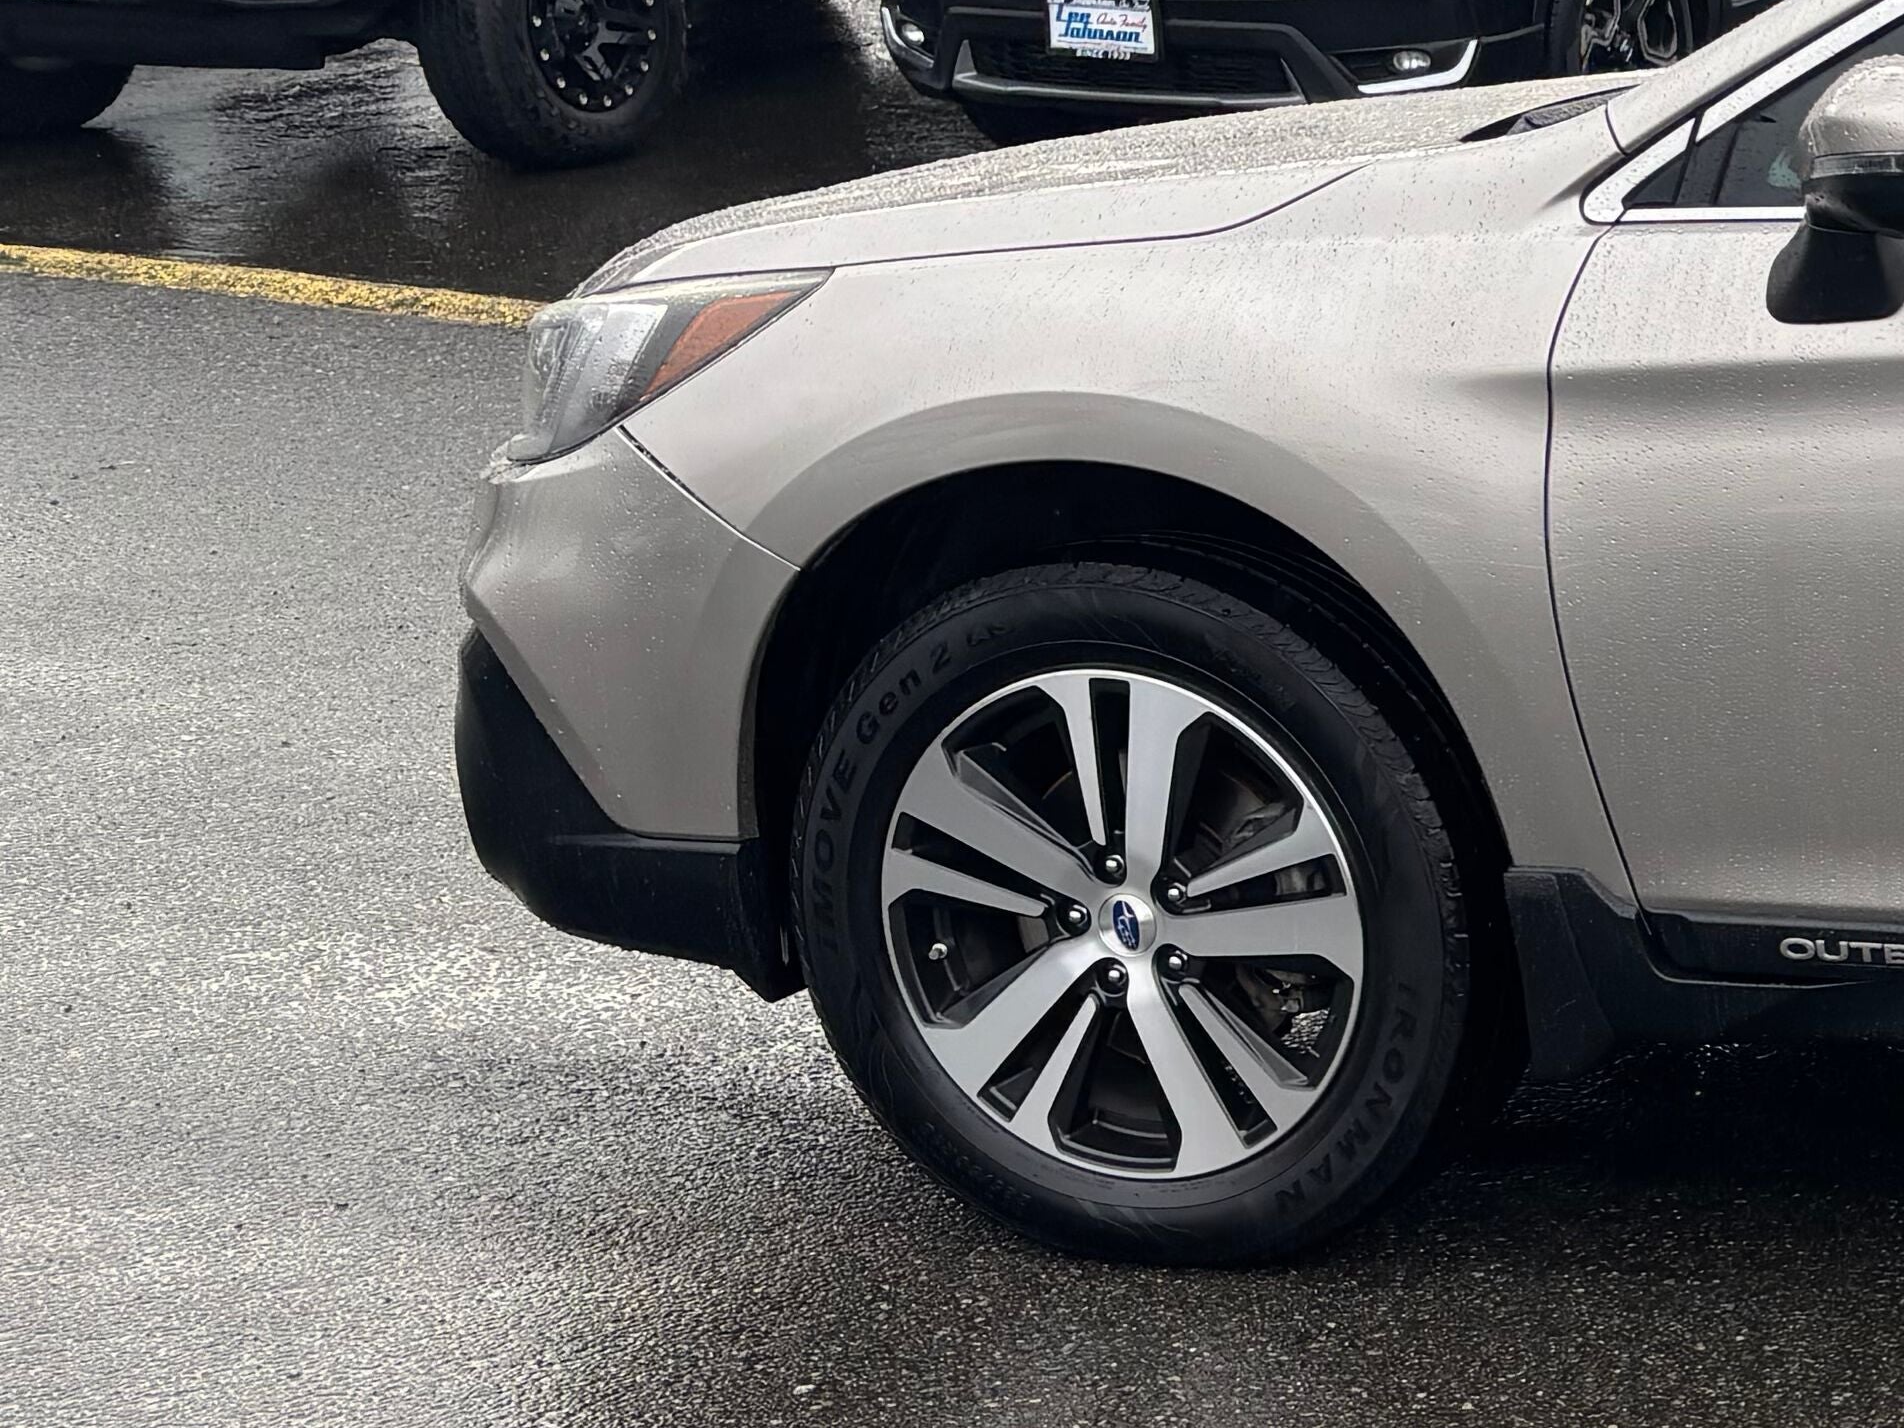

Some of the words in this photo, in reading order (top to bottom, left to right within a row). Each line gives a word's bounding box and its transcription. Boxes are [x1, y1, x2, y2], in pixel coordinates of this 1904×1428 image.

[1056, 3, 1093, 25] Lee
[1058, 21, 1144, 43] Johnson
[856, 667, 922, 744] Gen
[929, 642, 952, 675] 2
[1276, 982, 1417, 1212] IRONMAN
